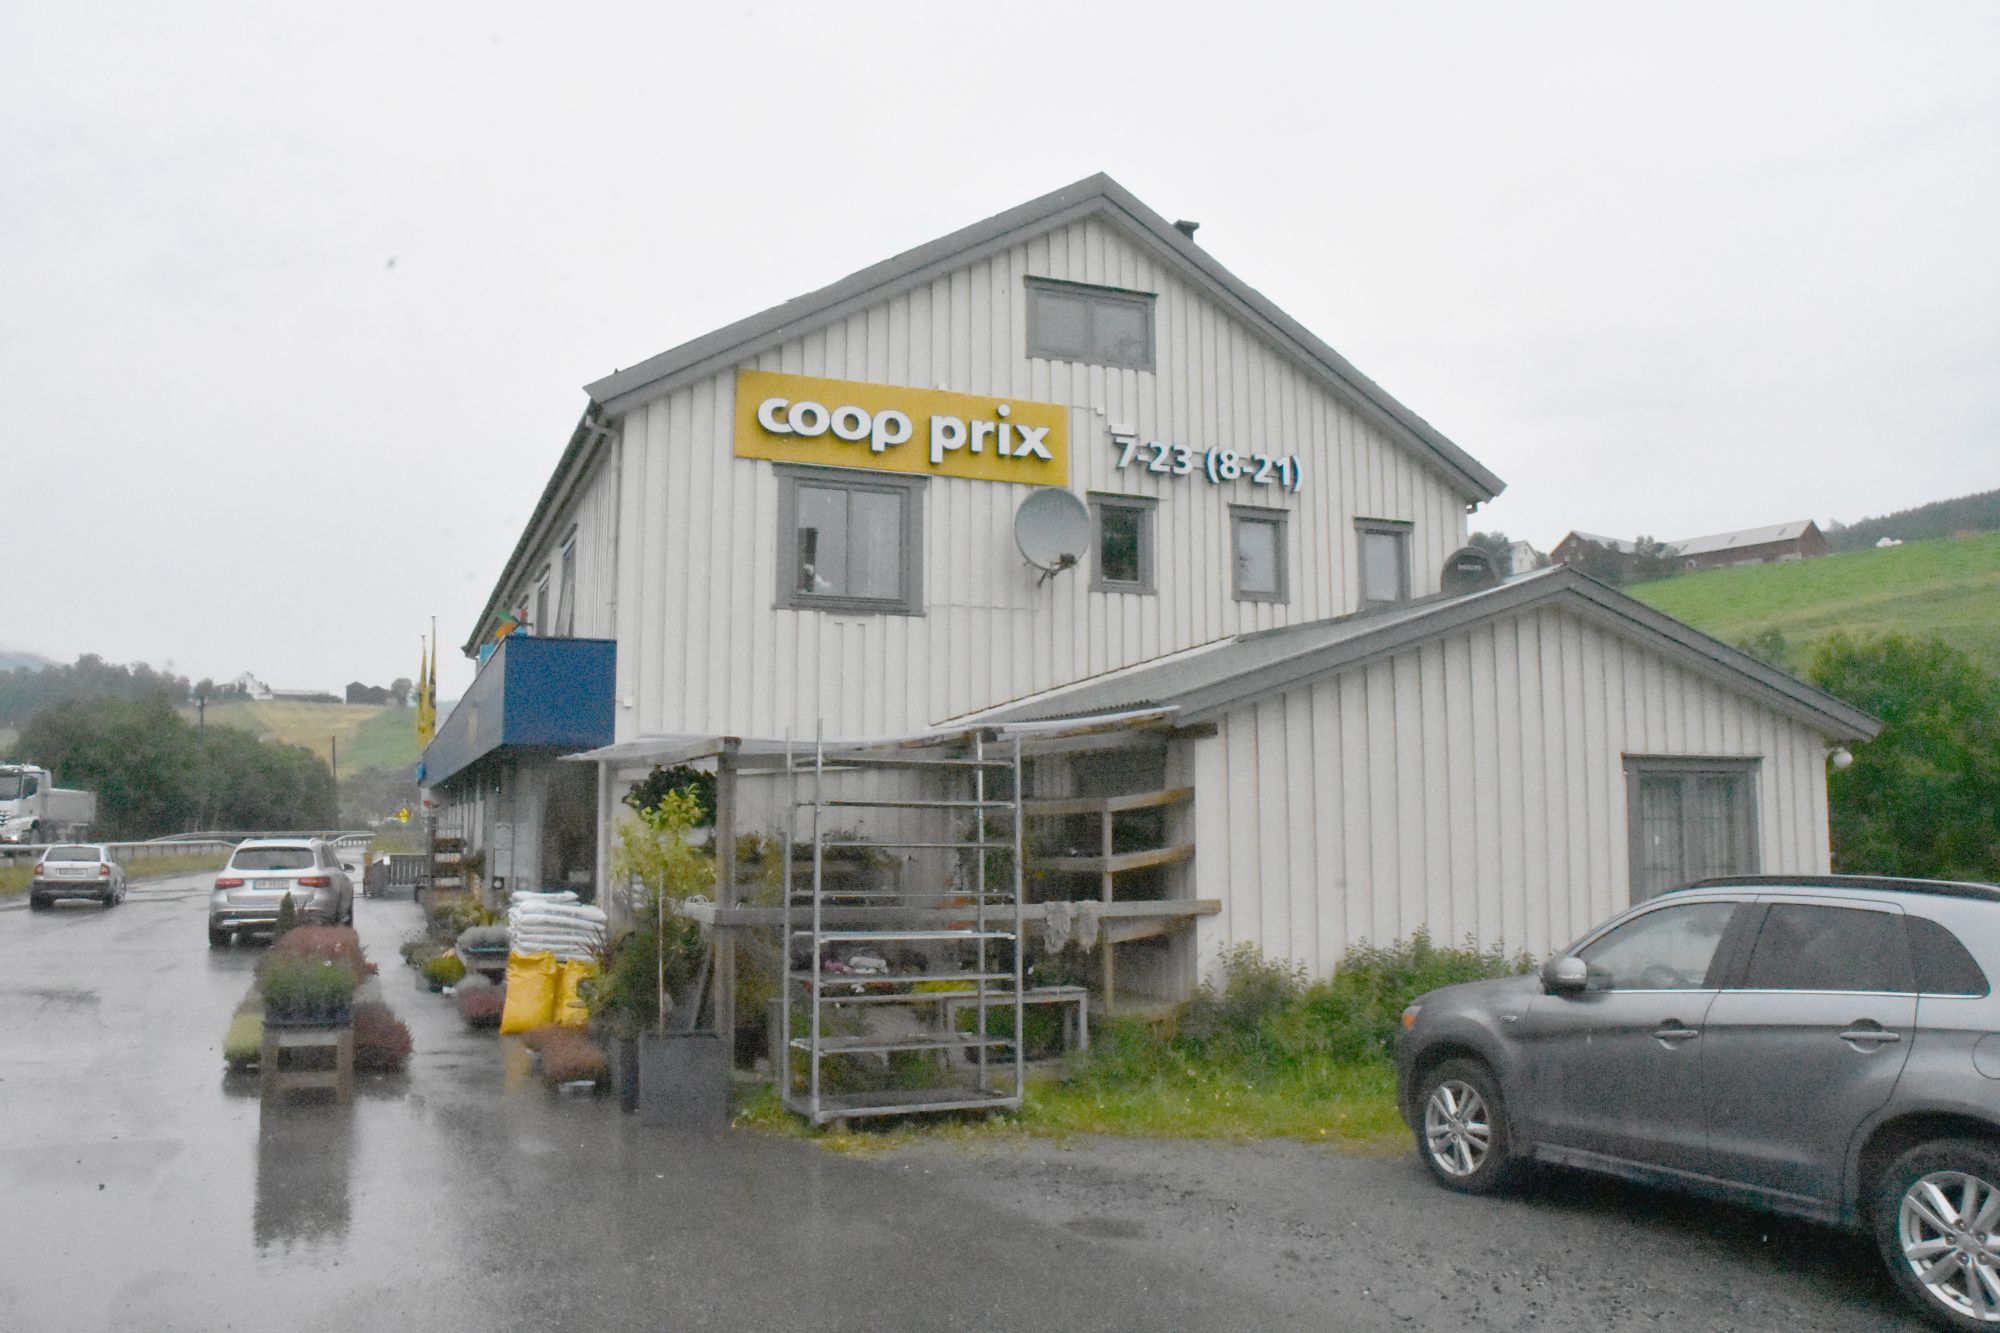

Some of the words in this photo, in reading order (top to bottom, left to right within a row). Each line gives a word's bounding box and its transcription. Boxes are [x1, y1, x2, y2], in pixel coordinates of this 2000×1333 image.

[757, 397, 913, 453] coop
[929, 403, 1053, 464] prix
[1114, 436, 1194, 476] 7-23
[1205, 445, 1304, 494] (8-21)
